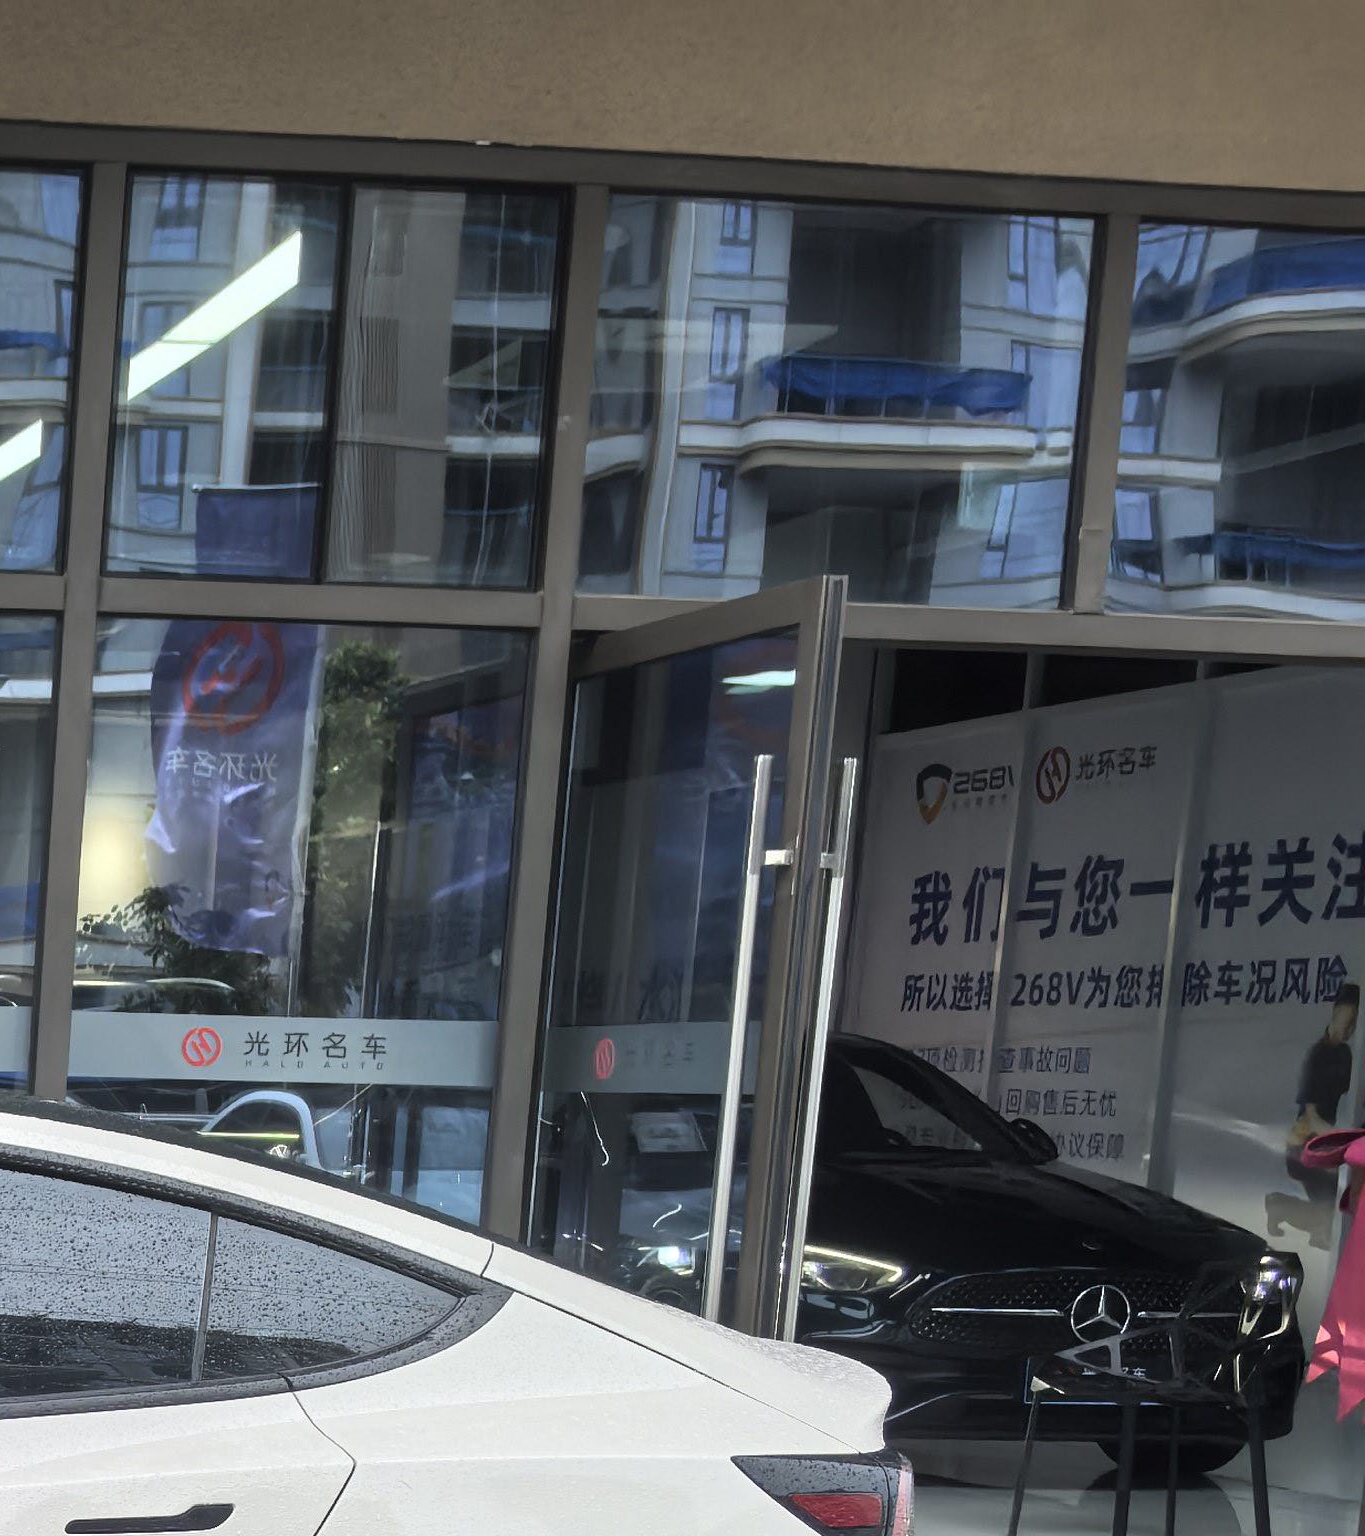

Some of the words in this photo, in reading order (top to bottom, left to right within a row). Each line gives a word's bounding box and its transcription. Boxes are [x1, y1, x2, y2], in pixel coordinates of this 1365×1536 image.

[1076, 745, 1158, 781] 光环名车
[243, 1031, 387, 1060] 光环名车
[324, 1061, 384, 1071] AUTO
